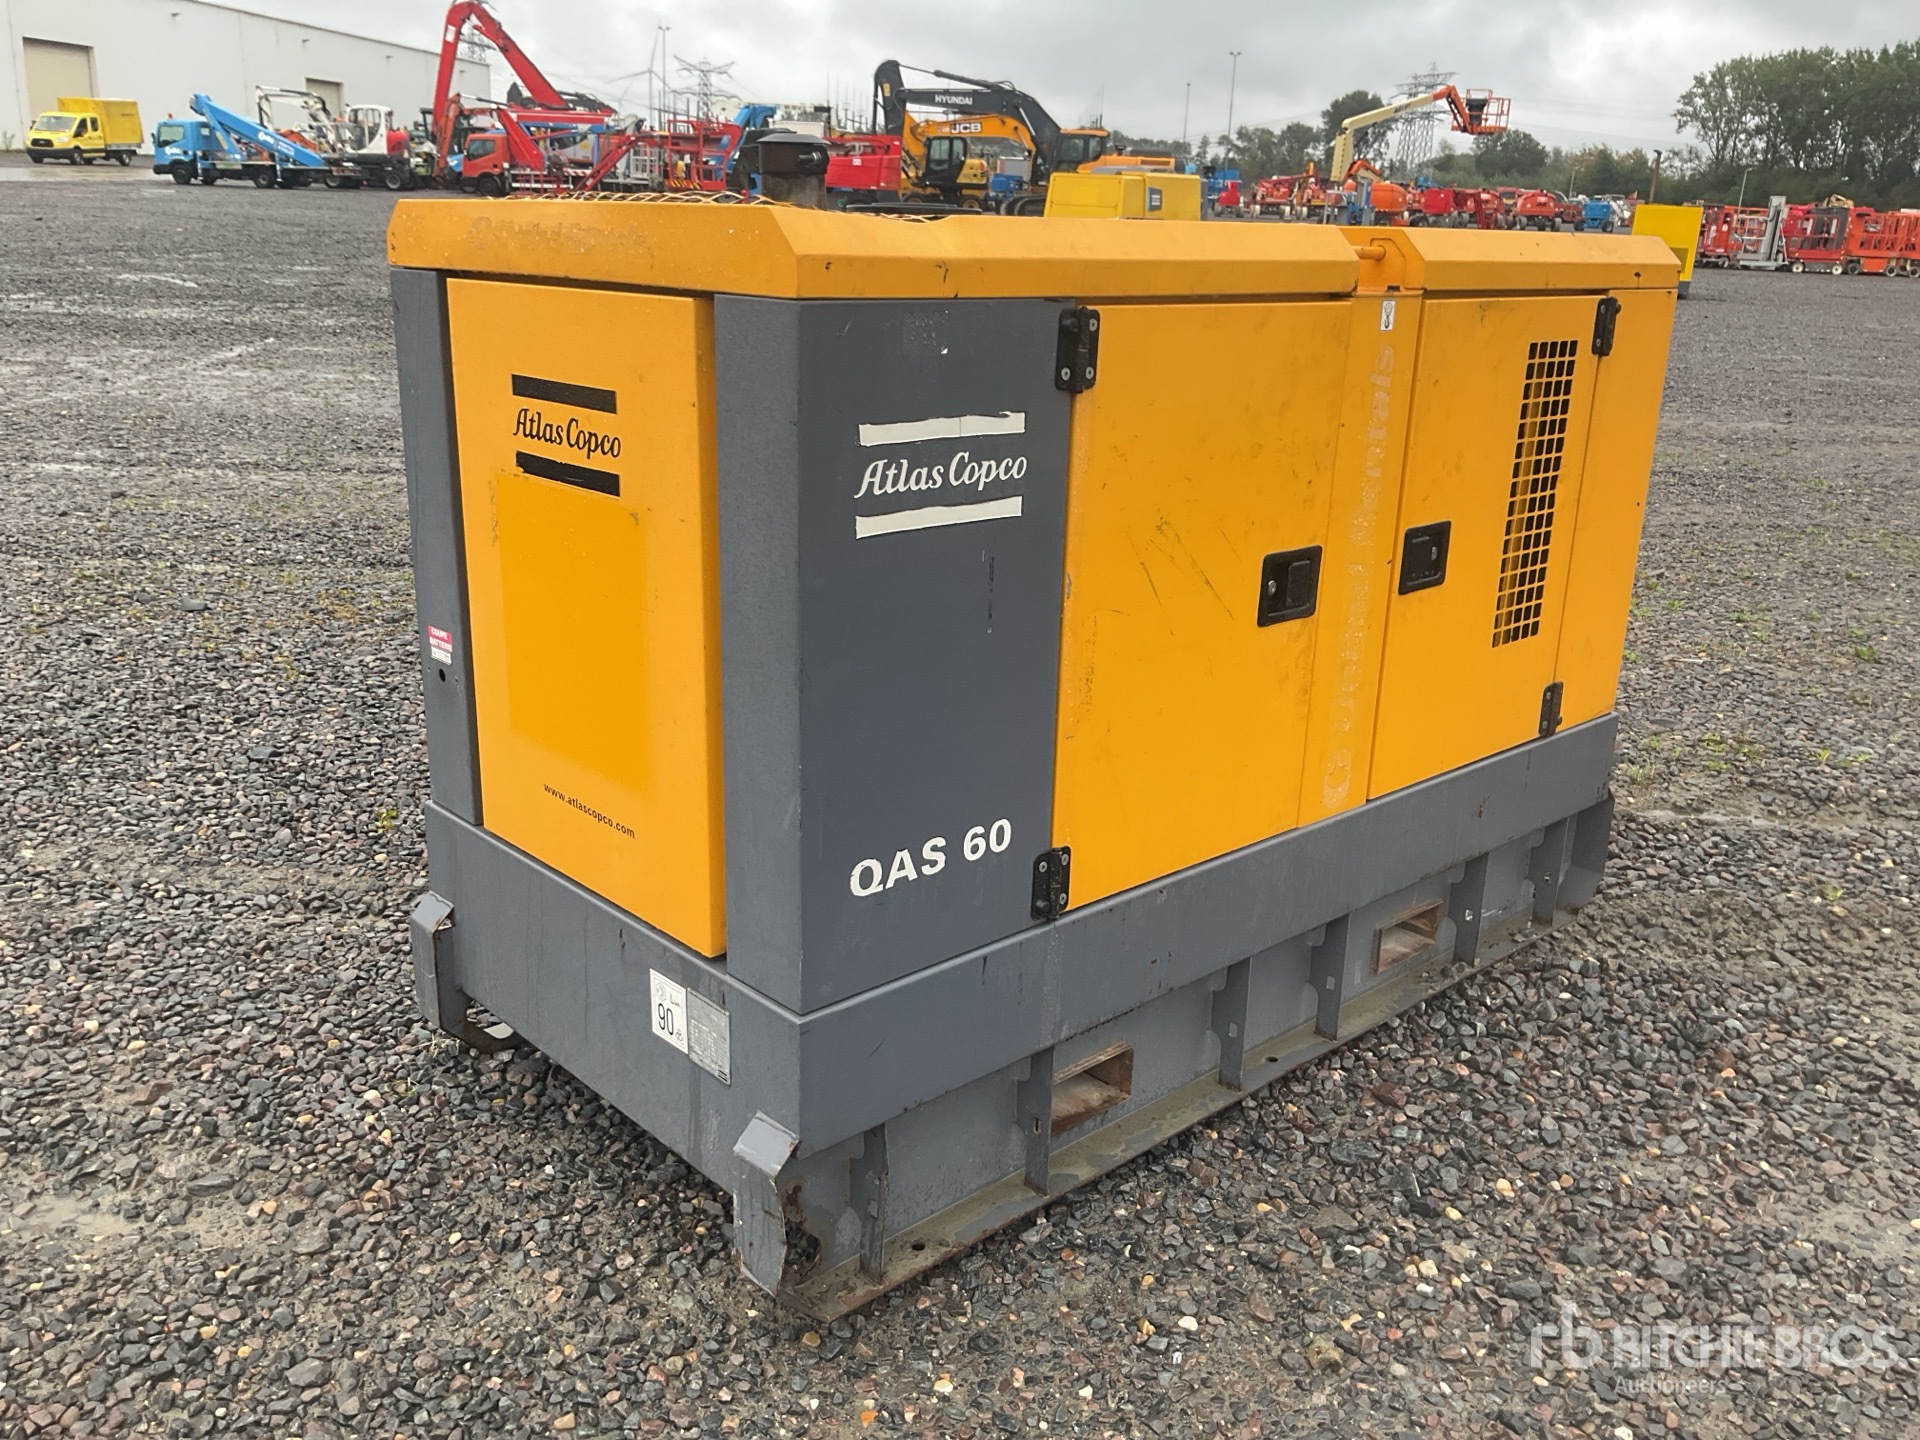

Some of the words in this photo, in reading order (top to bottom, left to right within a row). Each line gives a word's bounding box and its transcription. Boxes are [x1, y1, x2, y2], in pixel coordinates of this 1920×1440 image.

[935, 94, 973, 105] HYUNDAI
[951, 122, 982, 134] JCB
[513, 408, 563, 446] Atlas
[566, 417, 621, 459] Copco
[853, 459, 945, 499] Atlas
[950, 451, 1028, 491] Copco
[543, 783, 635, 838] www.atlascopco.com
[850, 836, 947, 897] QAS
[963, 818, 1012, 861] 60
[658, 1002, 674, 1036] 90
